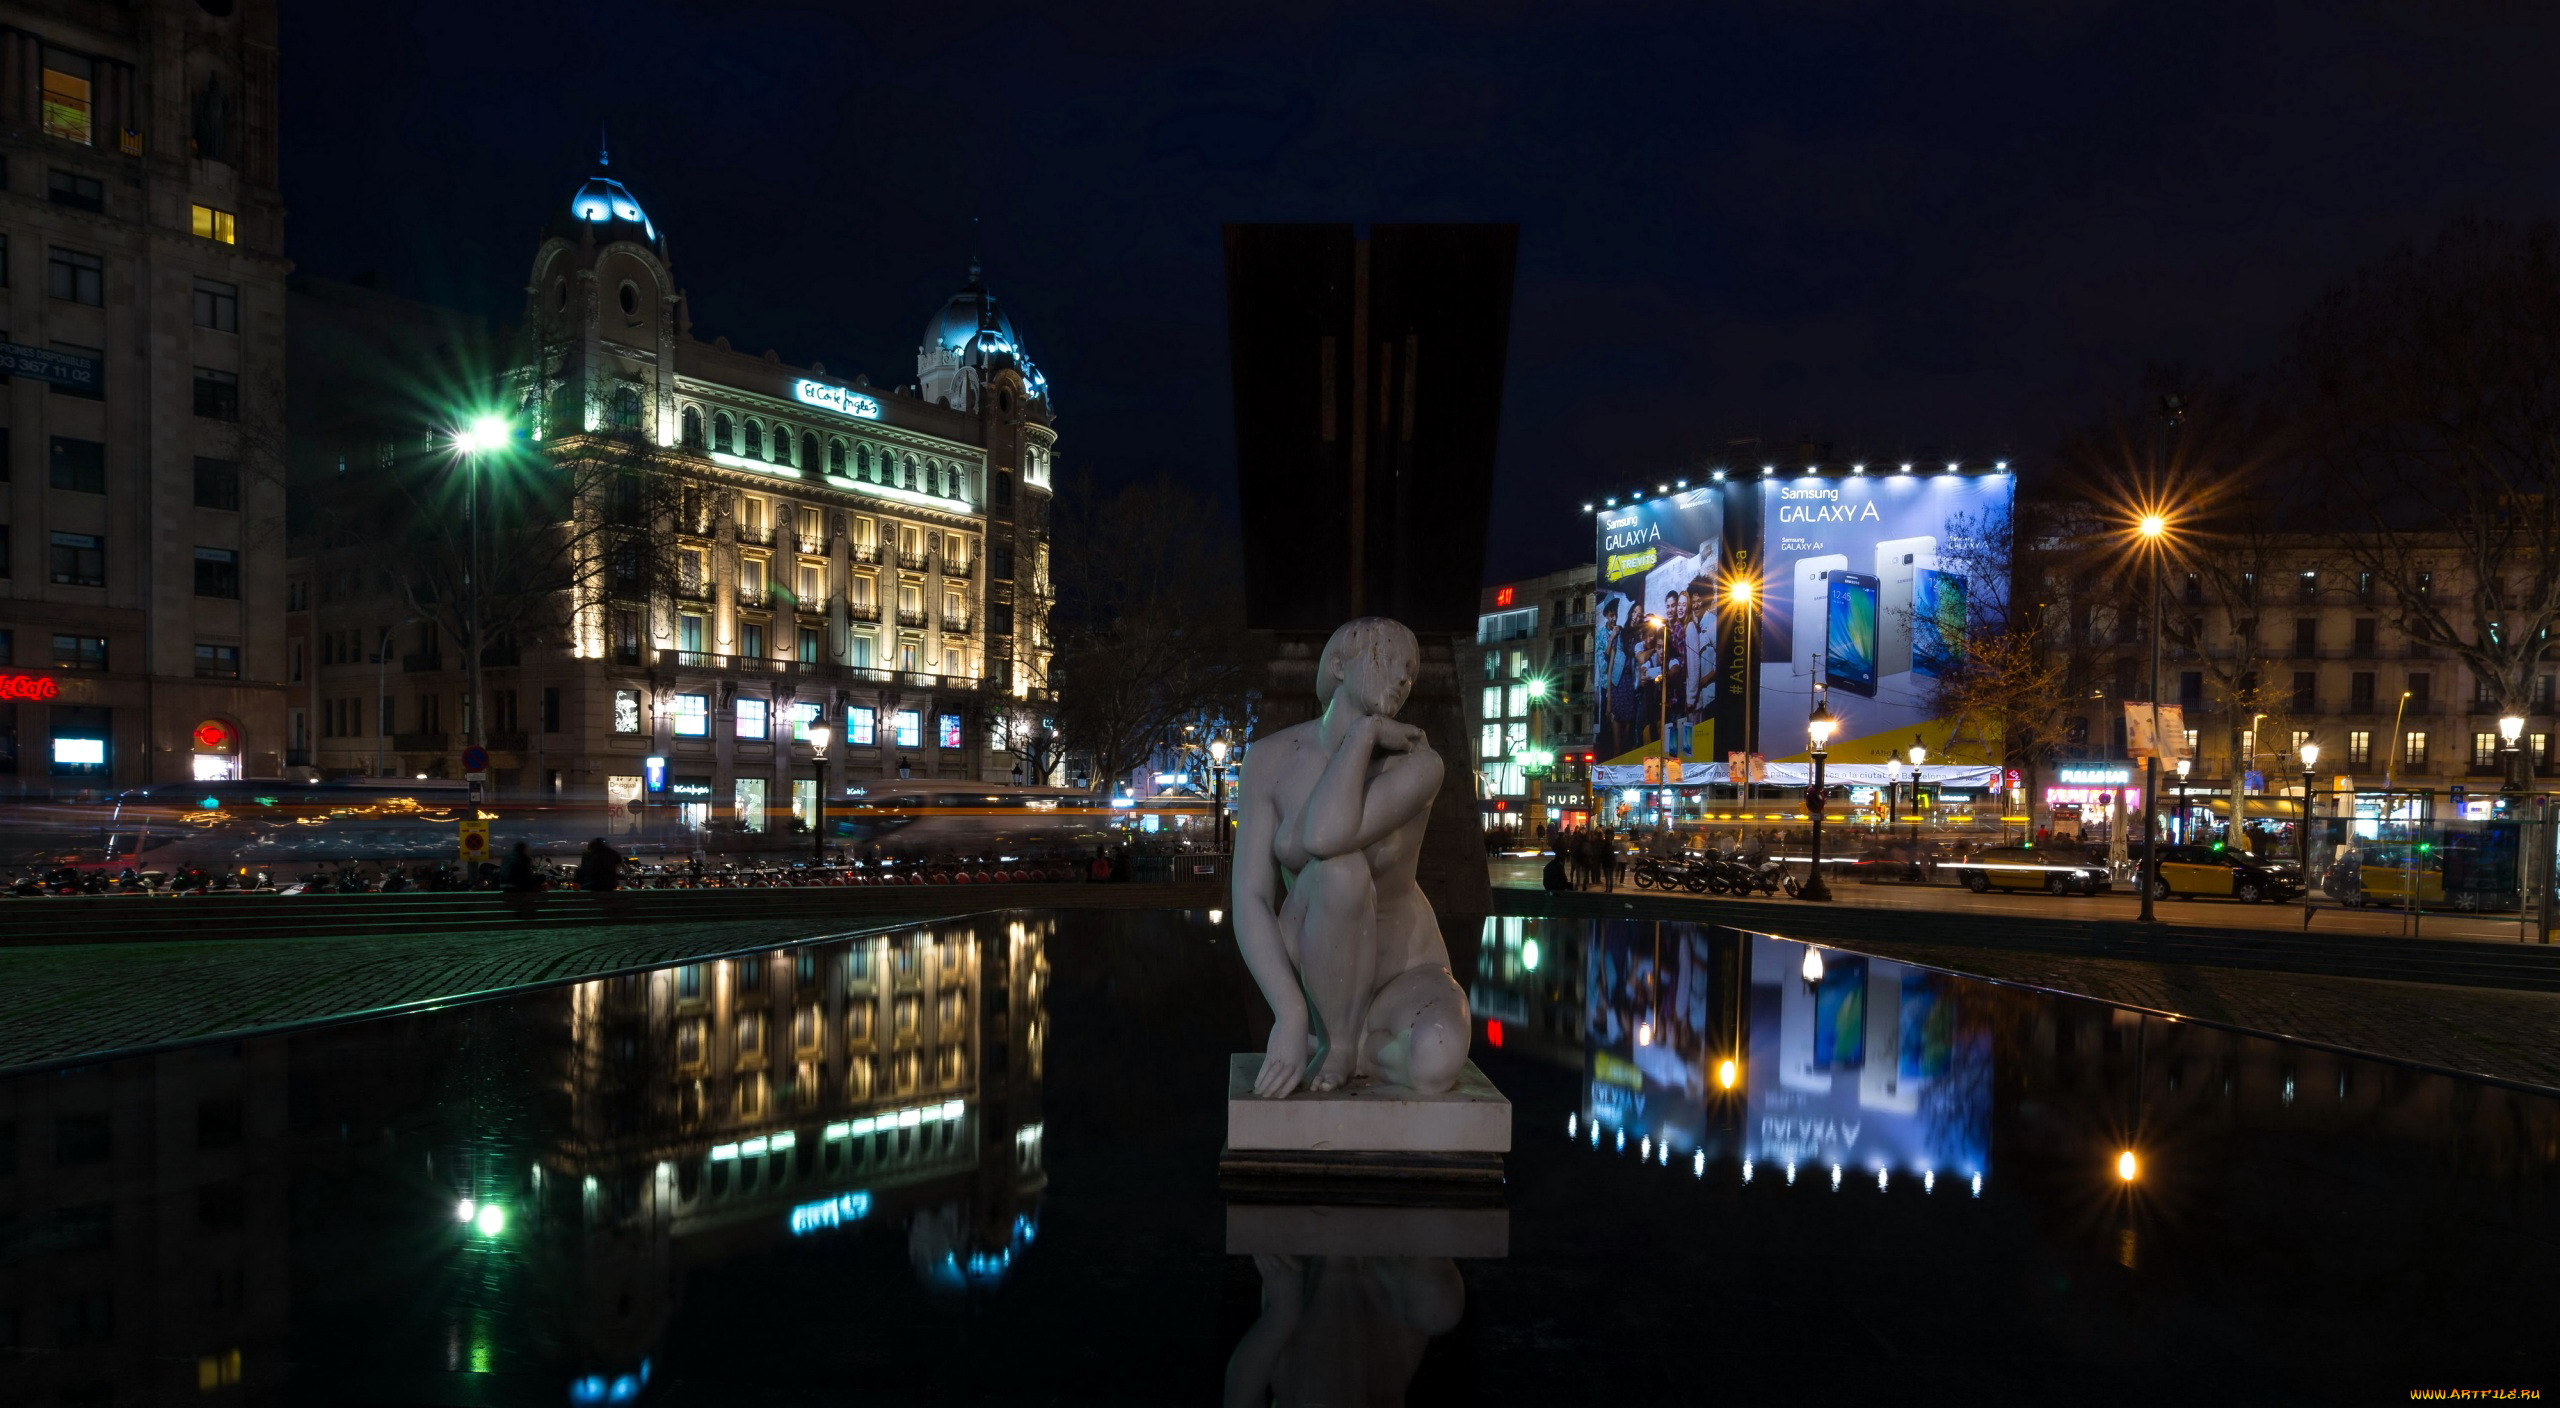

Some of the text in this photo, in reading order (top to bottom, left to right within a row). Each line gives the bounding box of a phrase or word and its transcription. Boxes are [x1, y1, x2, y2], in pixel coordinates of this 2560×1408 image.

[19, 359, 49, 374] 367
[53, 366, 67, 379] 11
[72, 370, 91, 383] 02
[804, 384, 877, 414] El Corte Inglés
[1781, 487, 1838, 502] Samsung
[1780, 500, 1880, 522] GALAXY A
[1606, 516, 1638, 531] Samsung
[1605, 522, 1661, 551] GALAXY A
[1781, 543, 1811, 551] GALAXY
[1607, 554, 1657, 578] ATREVITS
[1730, 549, 1747, 695] #Ahoraoca
[13, 676, 59, 701] Cafe
[1860, 771, 1886, 779] ciutat
[1902, 772, 1947, 780] Bacelona
[1547, 794, 1595, 805] NUR
